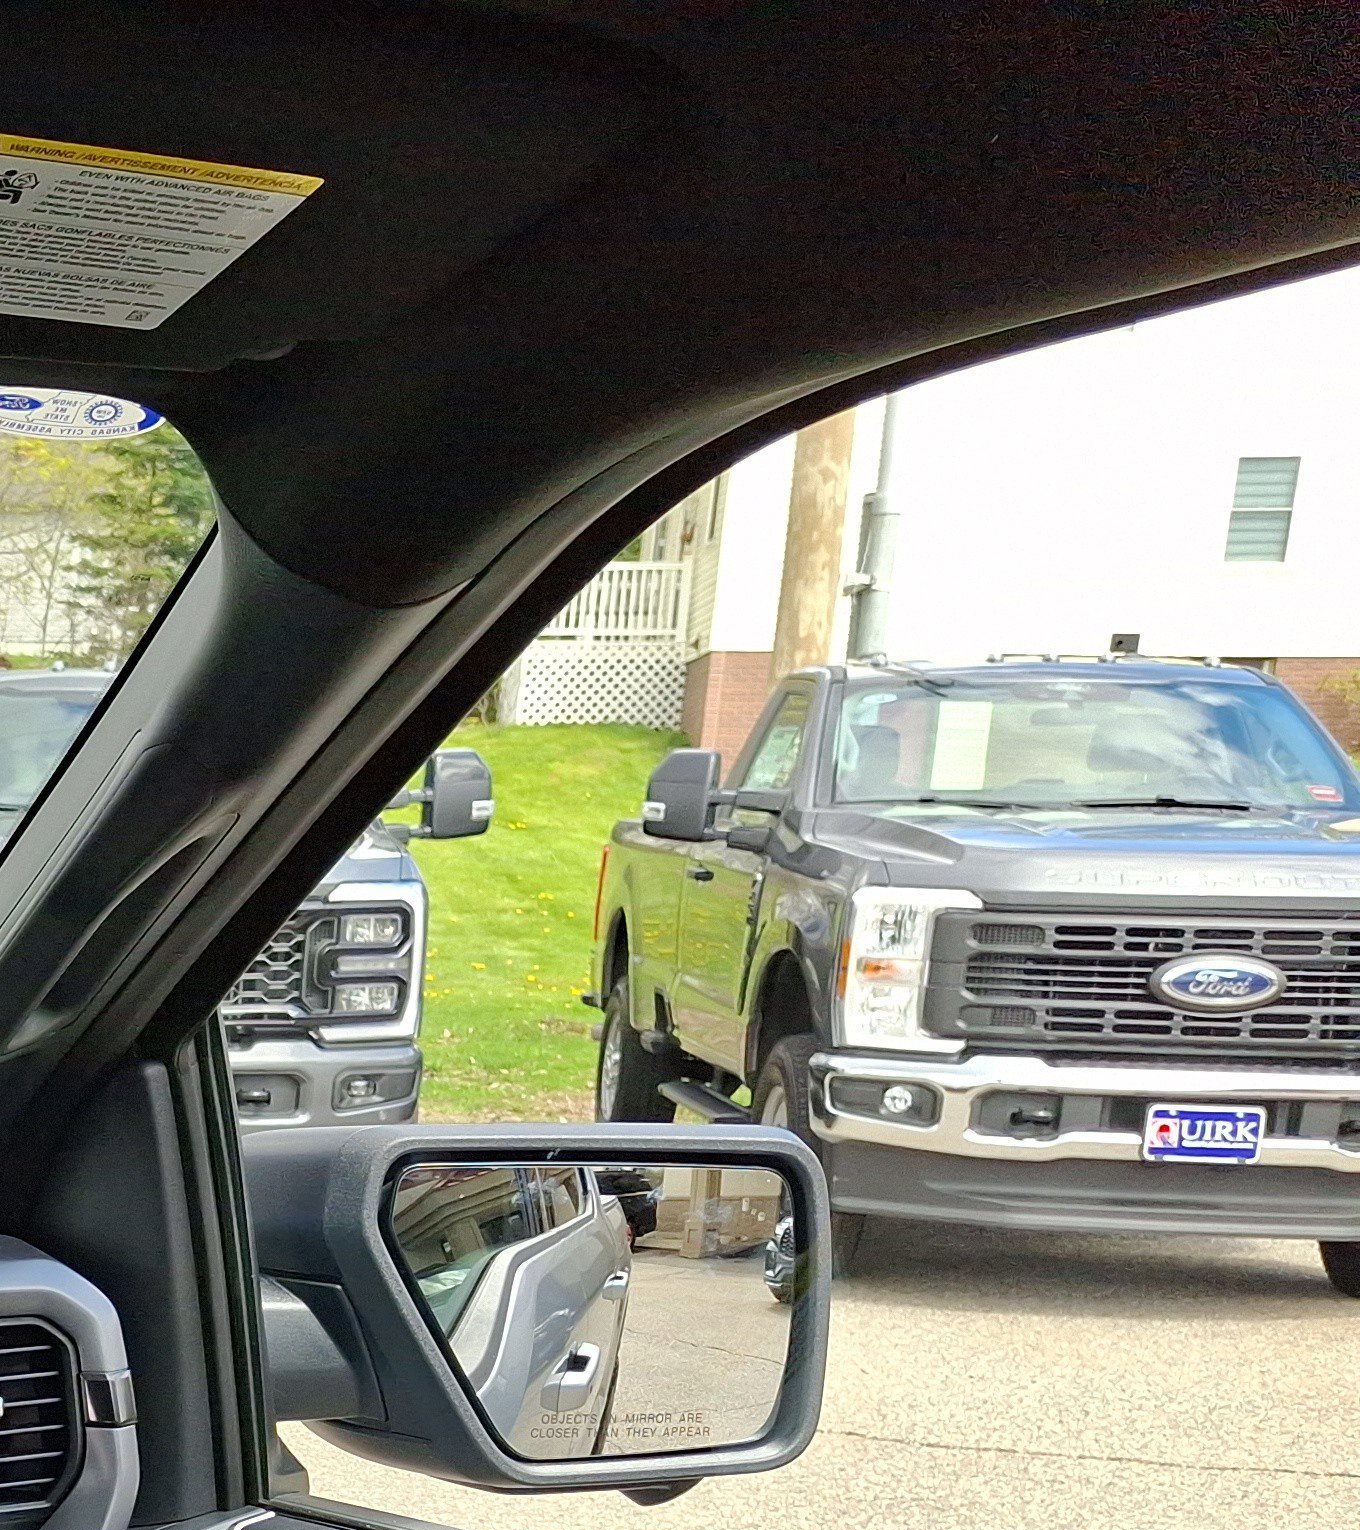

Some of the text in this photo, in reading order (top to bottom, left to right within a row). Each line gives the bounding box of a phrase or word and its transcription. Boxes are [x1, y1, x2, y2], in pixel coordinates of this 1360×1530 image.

[10, 143, 76, 160] WARNING
[80, 171, 114, 180] EVEN
[1188, 970, 1252, 996] Ford
[542, 1414, 597, 1424] OBJECTS
[625, 1414, 671, 1423] MIRROR
[678, 1413, 702, 1423] ARE
[531, 1428, 579, 1438] CLOSER
[627, 1428, 656, 1437] THEY
[663, 1426, 710, 1436] APPEAR
